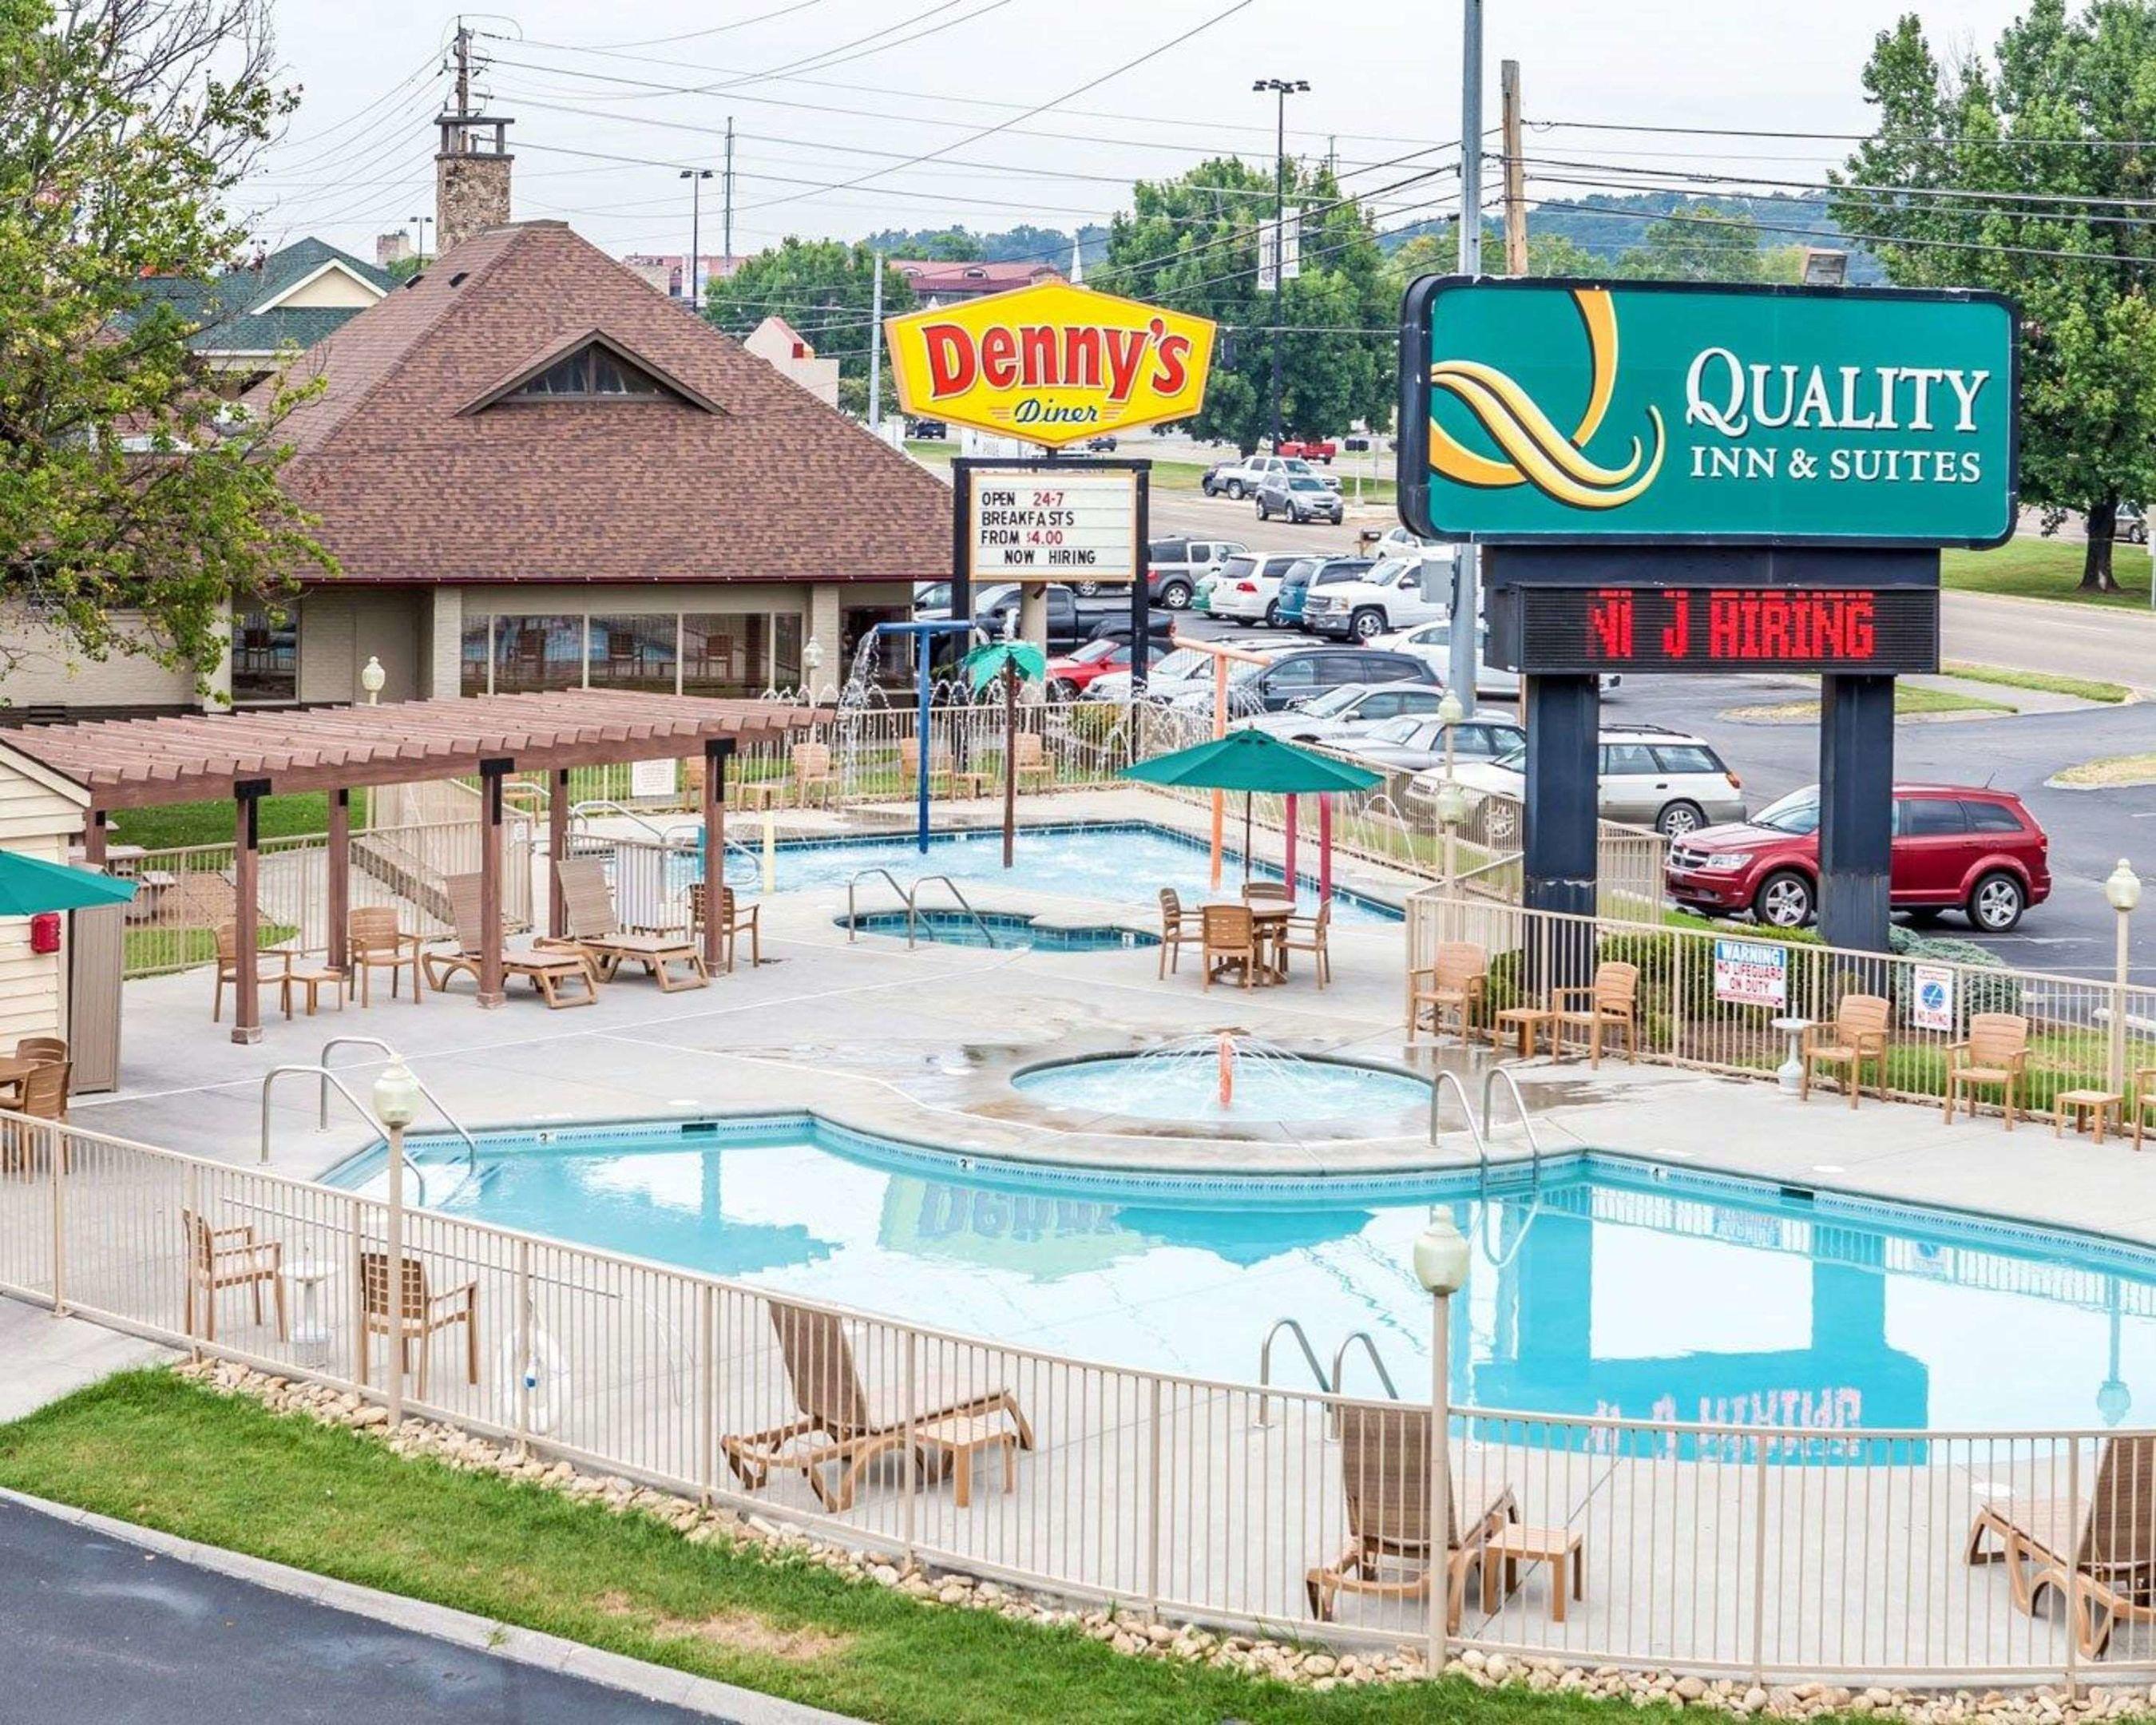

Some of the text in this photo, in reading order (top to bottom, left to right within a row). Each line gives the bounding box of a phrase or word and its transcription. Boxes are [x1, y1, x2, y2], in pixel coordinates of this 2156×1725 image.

[921, 318, 1190, 399] Denny's
[1685, 346, 1990, 438] QUALITY
[1015, 398, 1098, 422] Diner
[1690, 446, 1982, 483] INN & SUITES
[981, 491, 1064, 507] OPEN 24-7
[981, 510, 1075, 526] BREAKFASTS
[981, 529, 1064, 545] FROM $4.00
[1004, 549, 1096, 565] NOW HIRING
[1721, 942, 1781, 965] WARNING
[1718, 961, 1783, 981] NO LIFEGUARD
[1730, 976, 1770, 993] ON DUTY
